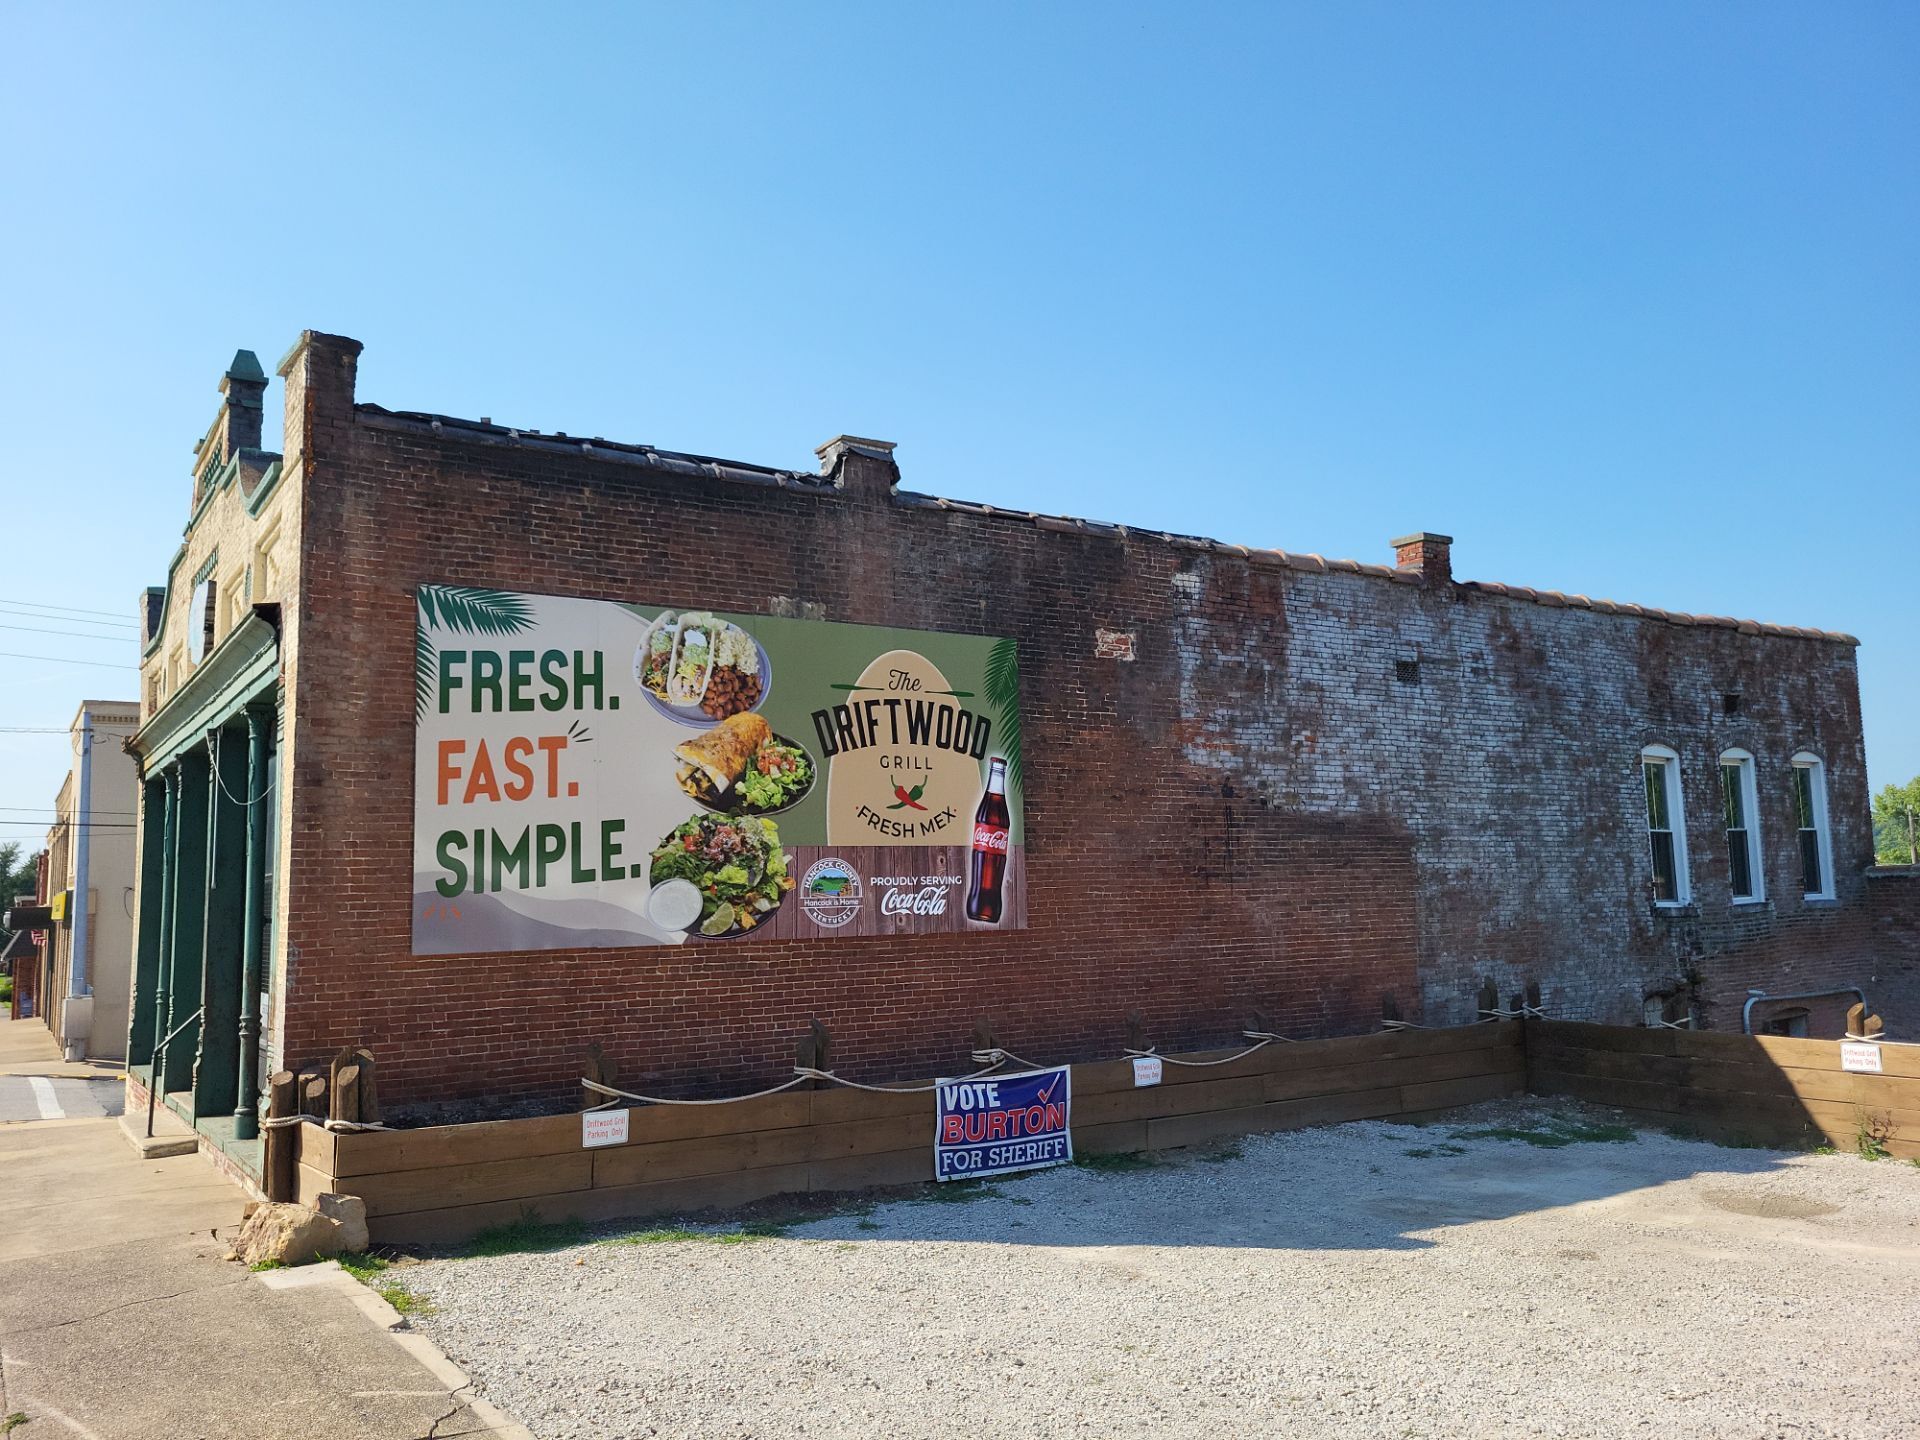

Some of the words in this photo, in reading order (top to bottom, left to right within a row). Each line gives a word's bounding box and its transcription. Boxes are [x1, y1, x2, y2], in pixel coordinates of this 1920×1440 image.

[439, 649, 620, 713] FRESH.
[888, 669, 922, 691] The
[810, 698, 992, 761] DRIFTWOOD
[437, 735, 579, 805] FAST.
[879, 755, 933, 770] GRILL
[857, 805, 915, 838] FRESH
[920, 806, 957, 836] MEX
[435, 819, 641, 898] SIMPLE.
[804, 861, 834, 888] HANCOCK
[835, 862, 859, 886] COUNTY
[870, 876, 917, 886] PROUDLY
[920, 875, 962, 885] SERVING
[804, 899, 833, 907] Hancock
[840, 898, 859, 906] Home
[881, 886, 949, 916] Coca-Cola
[812, 910, 852, 924] KENTUCKY
[943, 1083, 1001, 1111] VOTE
[942, 1102, 1066, 1144] BURTON
[942, 1150, 982, 1172] FOR
[988, 1138, 1066, 1167] SHERIFF
